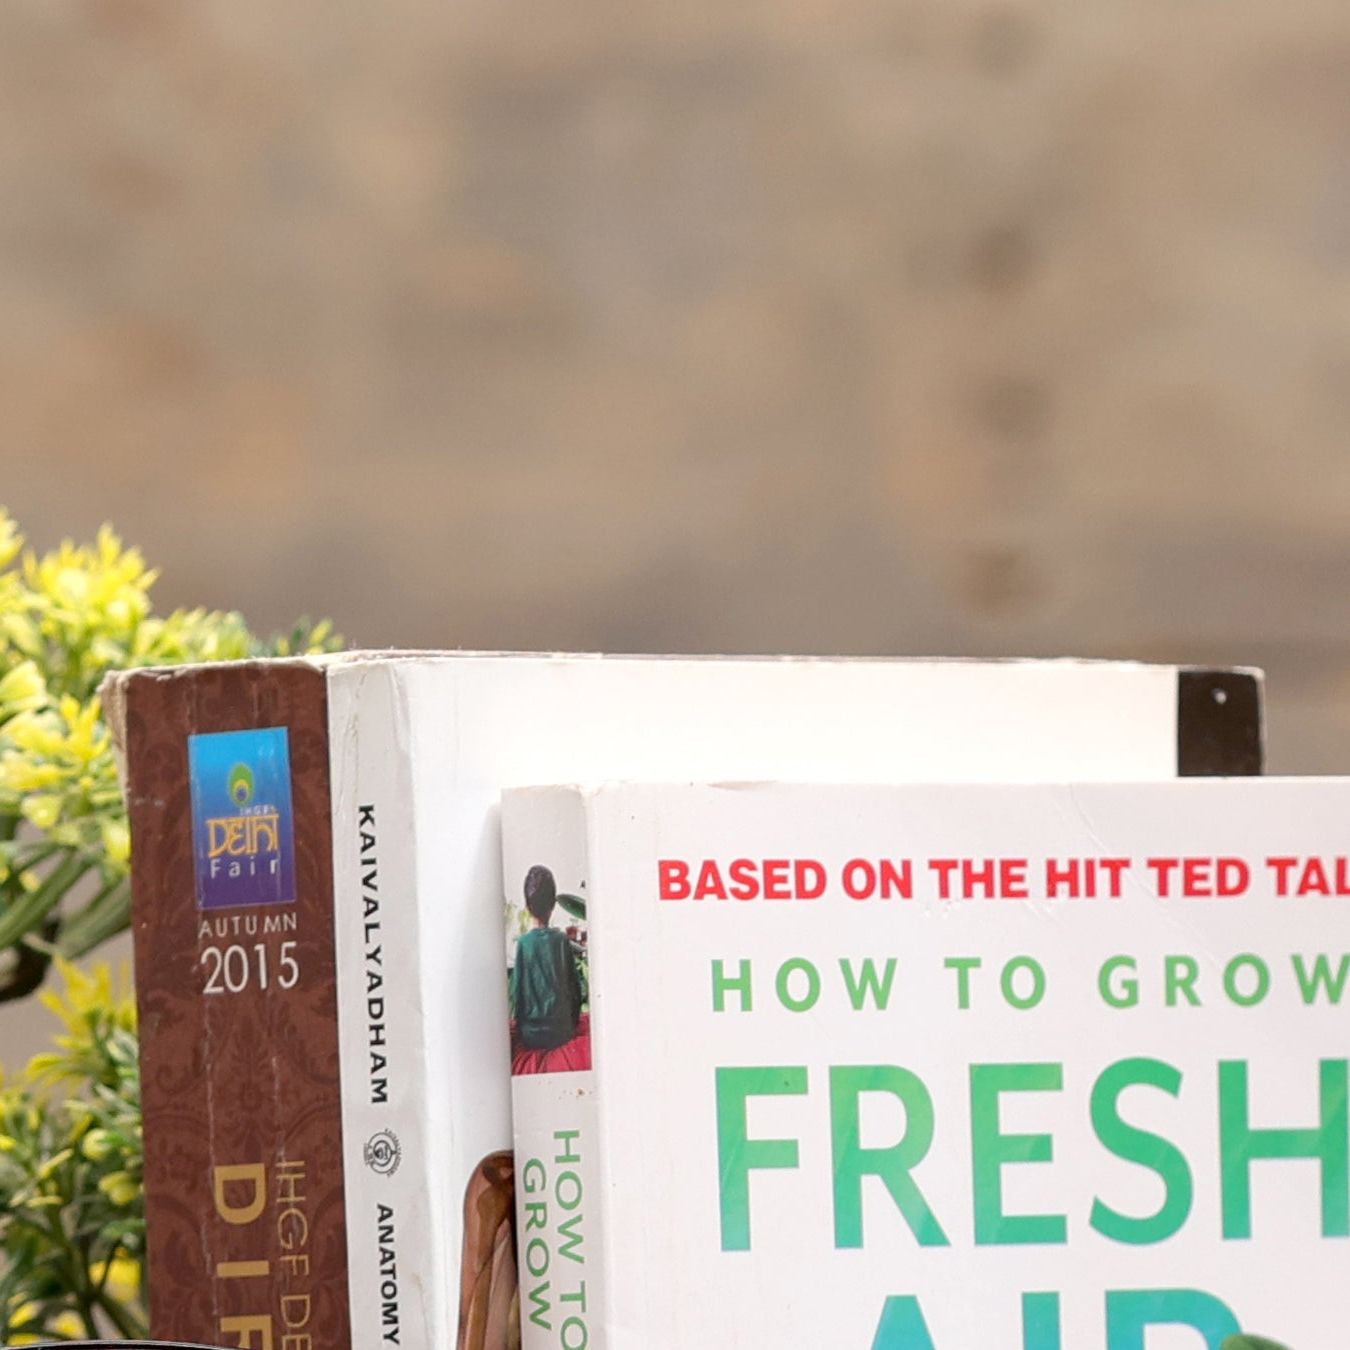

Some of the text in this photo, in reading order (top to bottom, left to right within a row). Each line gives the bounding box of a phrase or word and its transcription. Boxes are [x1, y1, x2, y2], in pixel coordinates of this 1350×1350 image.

[198, 912, 298, 939] AUTUMN
[210, 857, 279, 880] Fair
[657, 858, 827, 901] BASED
[841, 858, 912, 900] ON
[928, 858, 1029, 899] THE
[1045, 857, 1131, 899] HIT
[1146, 856, 1251, 898] TED
[201, 941, 299, 995] 2015
[358, 804, 389, 1104] KAIVALYADHAM
[710, 953, 1350, 1013] HOW TO GROW
[553, 1129, 585, 1264] HOW
[714, 1056, 1350, 1253] FRESH
[276, 1160, 310, 1277] IHGF
[377, 1203, 401, 1346] ANATOMY
[522, 1158, 552, 1331] GROW
